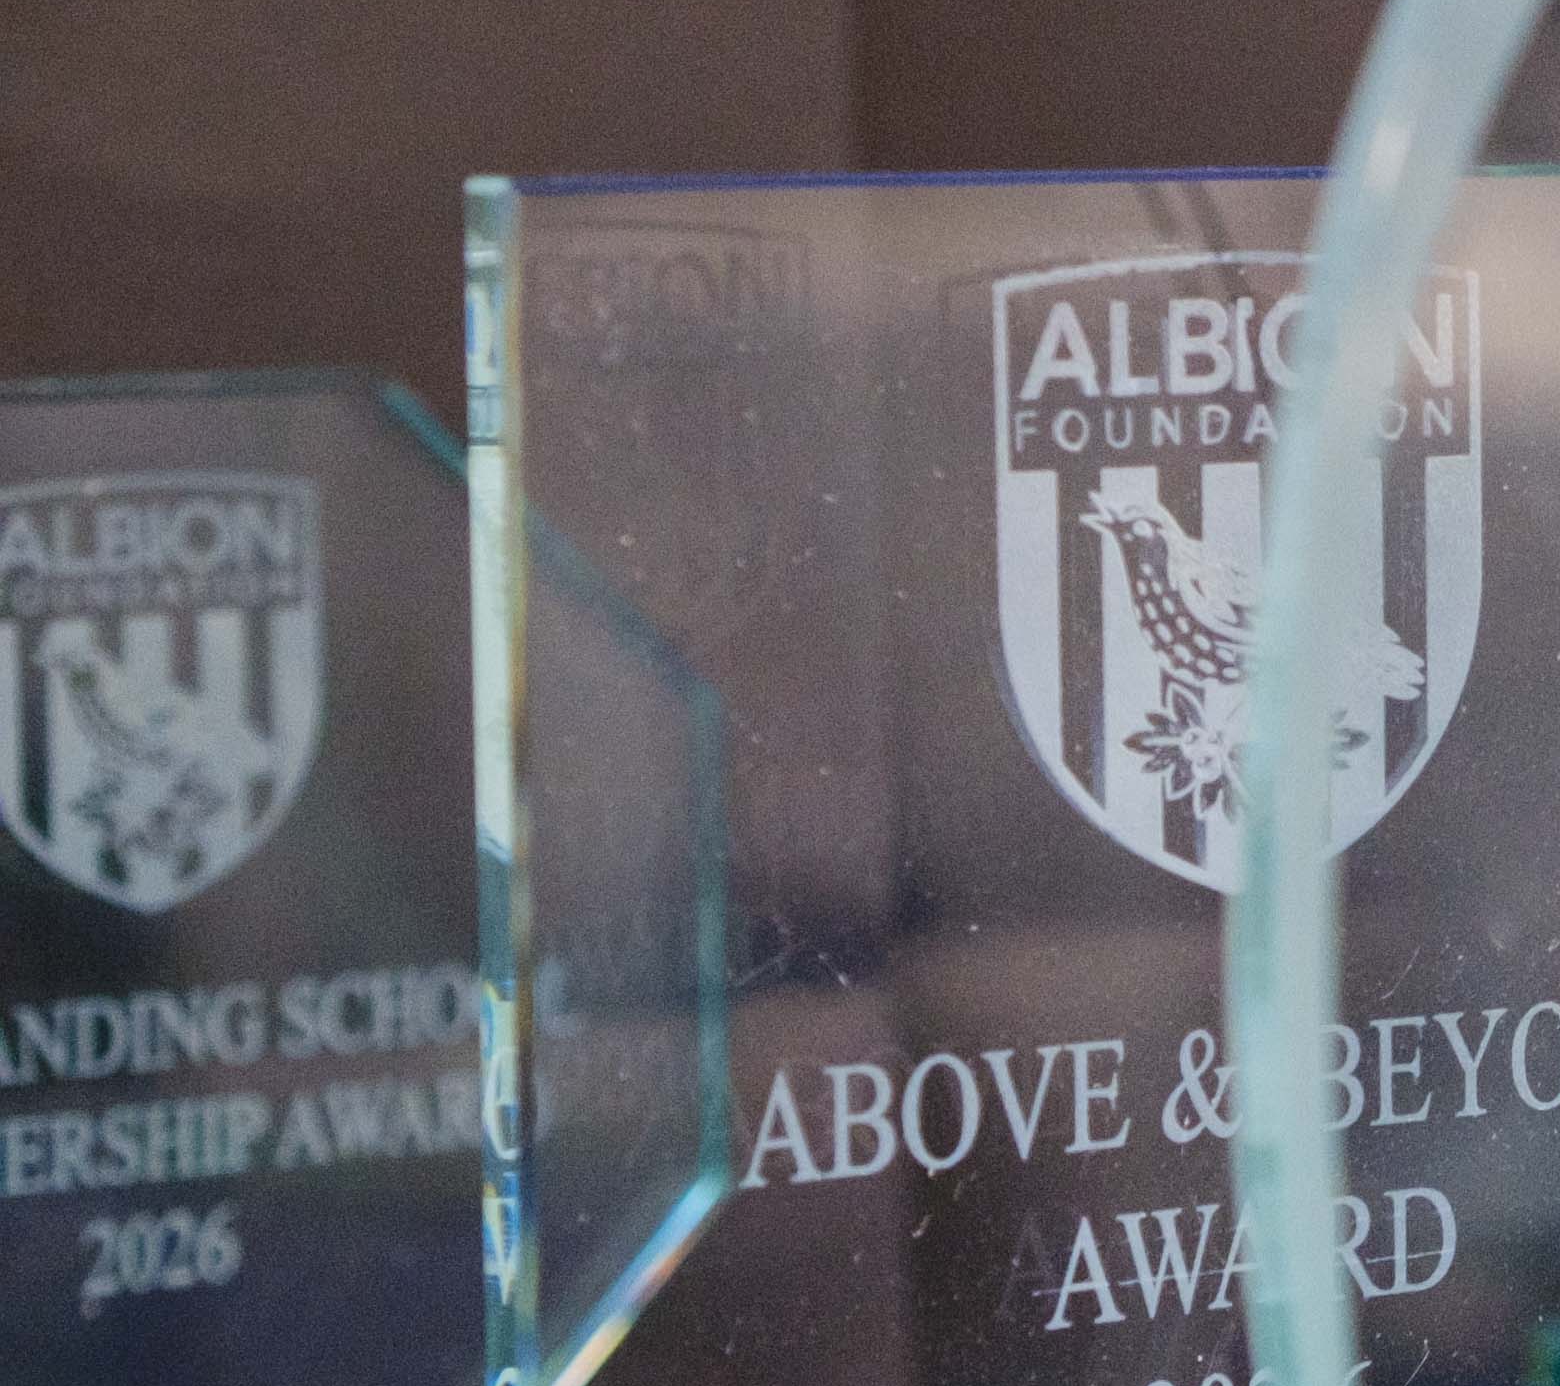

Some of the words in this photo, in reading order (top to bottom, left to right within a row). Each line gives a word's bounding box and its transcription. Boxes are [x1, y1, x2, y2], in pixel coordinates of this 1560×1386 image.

[1013, 397, 1453, 453] FOUNDAON
[276, 956, 578, 1059] SCHOL
[274, 1068, 553, 1173] AWAR
[739, 1039, 1132, 1190] ABOVE
[1160, 1028, 1245, 1144] &
[82, 1201, 243, 1301] 2026
